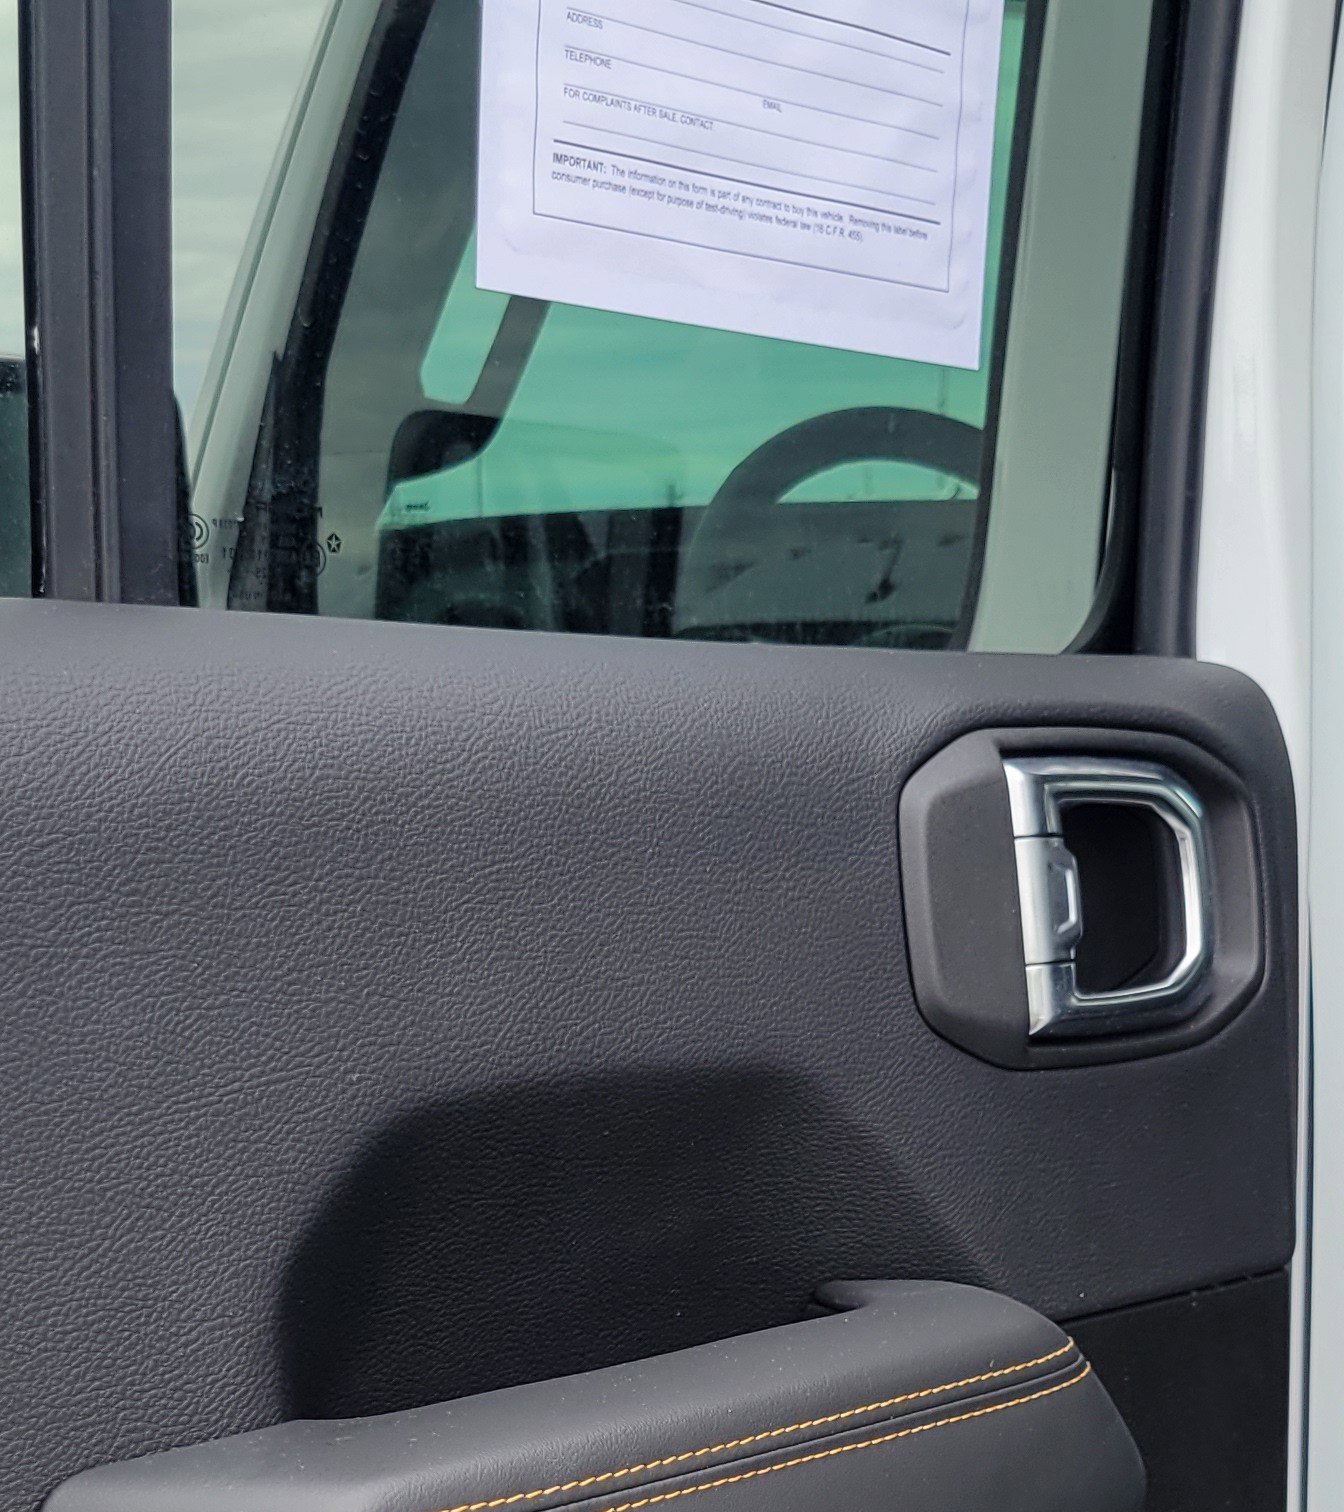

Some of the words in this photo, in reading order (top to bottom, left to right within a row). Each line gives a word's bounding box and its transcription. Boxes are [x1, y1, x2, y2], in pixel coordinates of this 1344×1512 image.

[566, 11, 603, 30] ADDRESS
[564, 49, 612, 70] TELEPHONE
[563, 87, 580, 100] FOR
[582, 92, 632, 112] COMPLAINTS
[633, 103, 657, 117] AFTER
[762, 99, 783, 114] EMAIL
[551, 170, 591, 187] consumer
[592, 179, 627, 196] purchase
[656, 190, 666, 201] for
[667, 193, 694, 209] purpose
[775, 214, 797, 229] federal
[552, 152, 607, 175] IMPORTANT:
[611, 164, 625, 178] The
[627, 167, 667, 187] information
[667, 178, 677, 188] on
[678, 179, 690, 192] this
[691, 182, 707, 195] form
[717, 188, 732, 201] part
[741, 194, 754, 207] any
[756, 198, 782, 212] contract
[792, 205, 804, 218] buy
[806, 206, 818, 218] this
[849, 214, 880, 234] Removing
